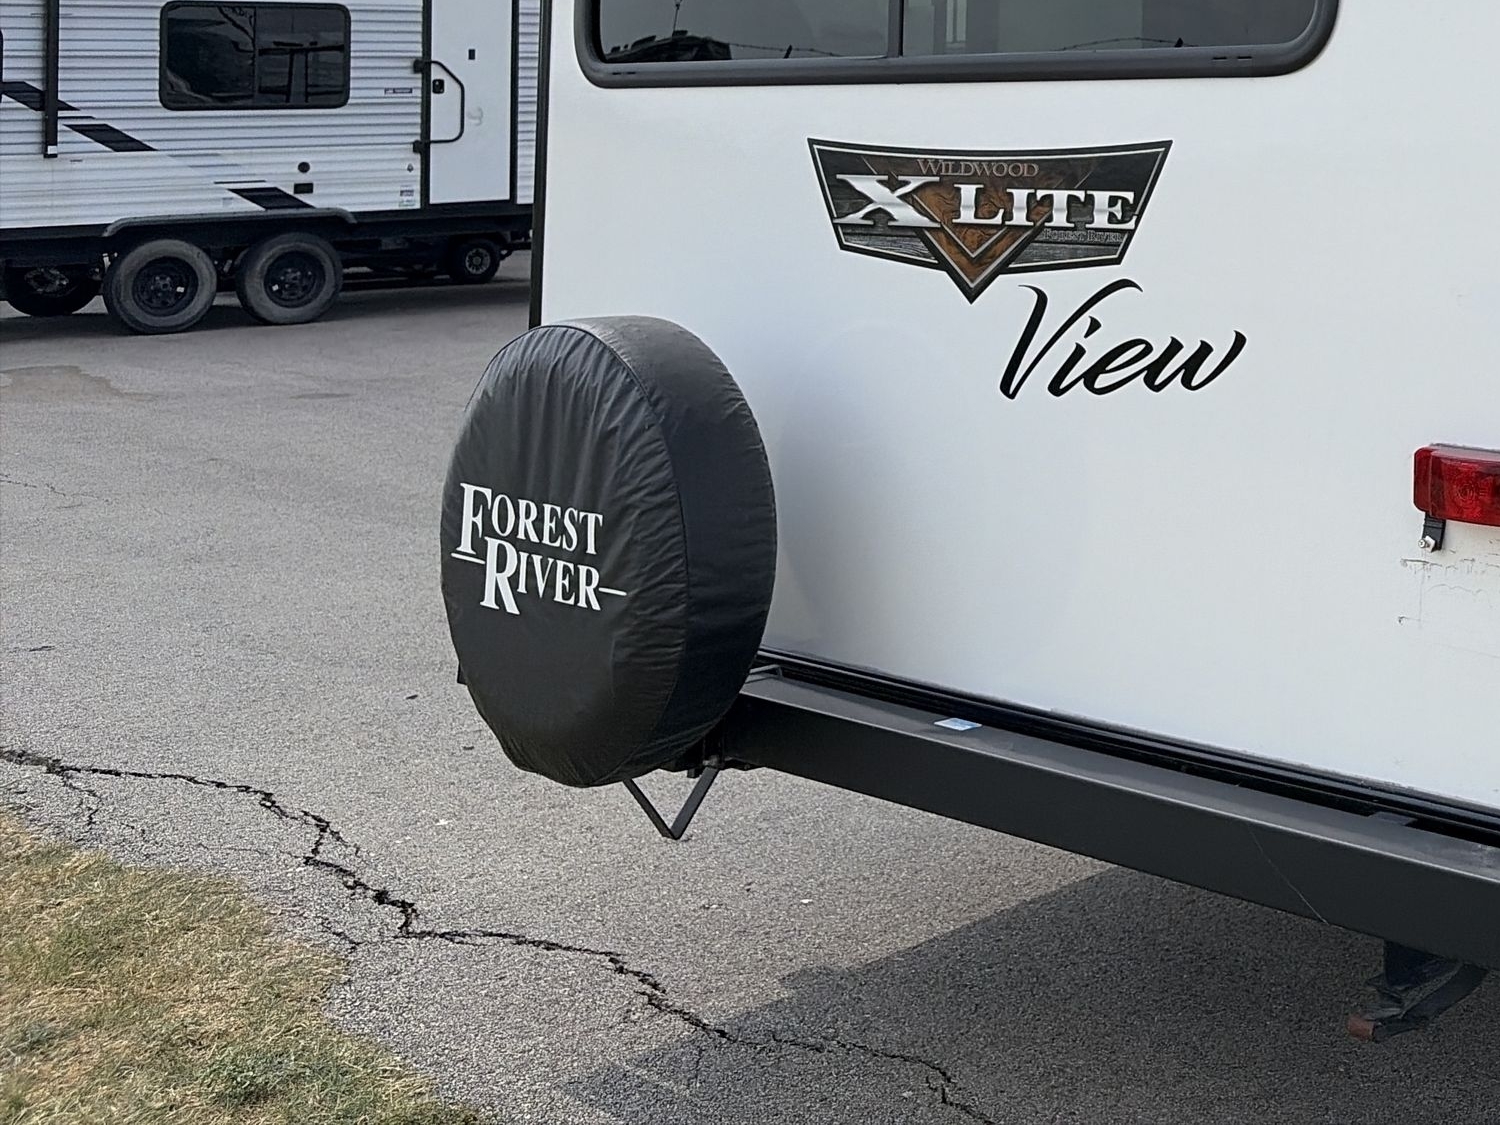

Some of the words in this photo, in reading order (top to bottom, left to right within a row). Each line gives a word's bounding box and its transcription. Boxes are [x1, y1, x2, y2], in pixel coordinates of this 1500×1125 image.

[833, 174, 941, 227] X
[952, 184, 1138, 230] LITE
[918, 159, 1038, 177] WILDWOOD
[1000, 278, 1247, 400] View
[456, 482, 603, 555] FOREST
[479, 536, 601, 615] RIVER
